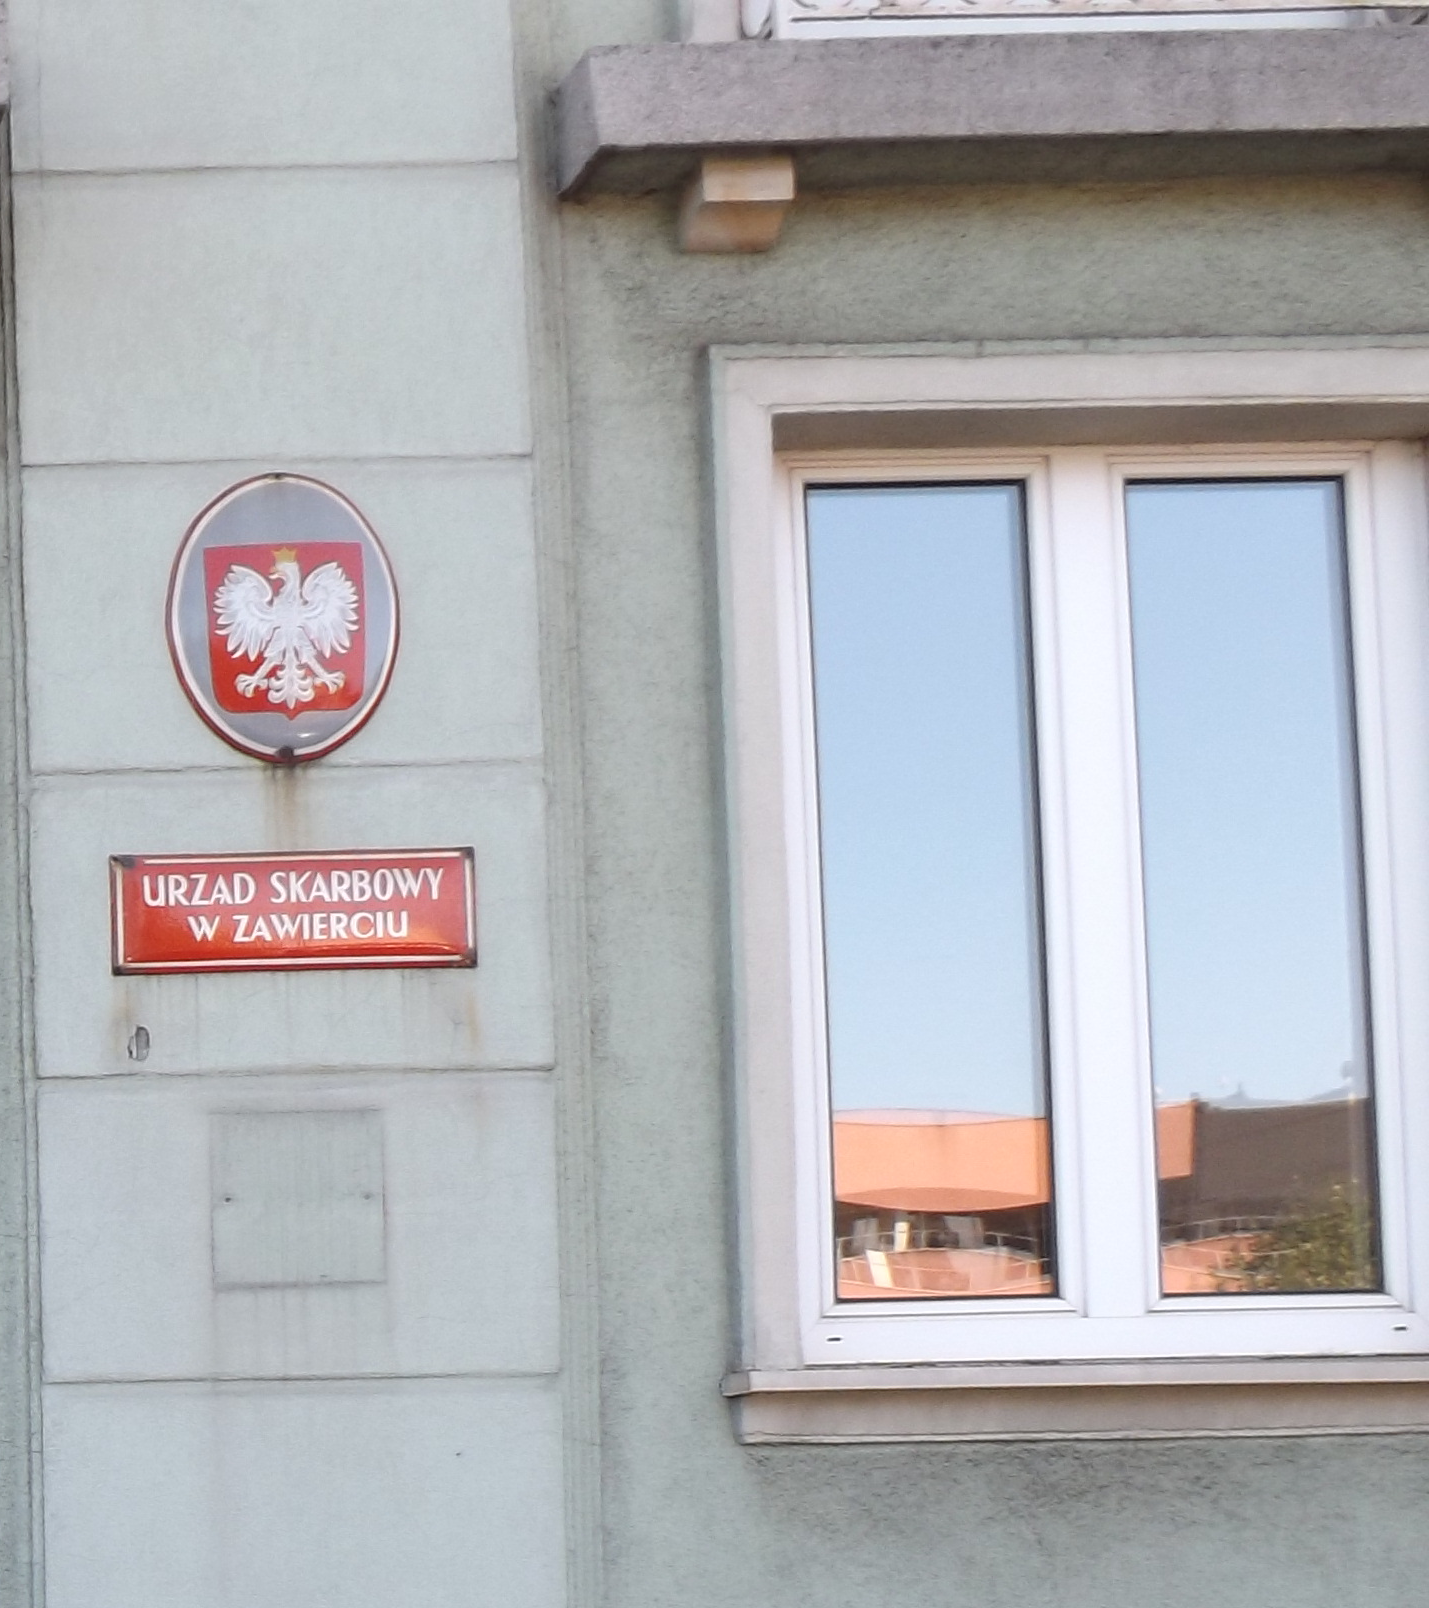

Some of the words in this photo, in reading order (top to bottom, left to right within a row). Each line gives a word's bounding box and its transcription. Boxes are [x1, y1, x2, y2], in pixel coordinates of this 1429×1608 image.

[269, 867, 445, 904] SKARBOWY
[186, 914, 221, 943] W
[231, 911, 409, 943] ZAWIERCIU
